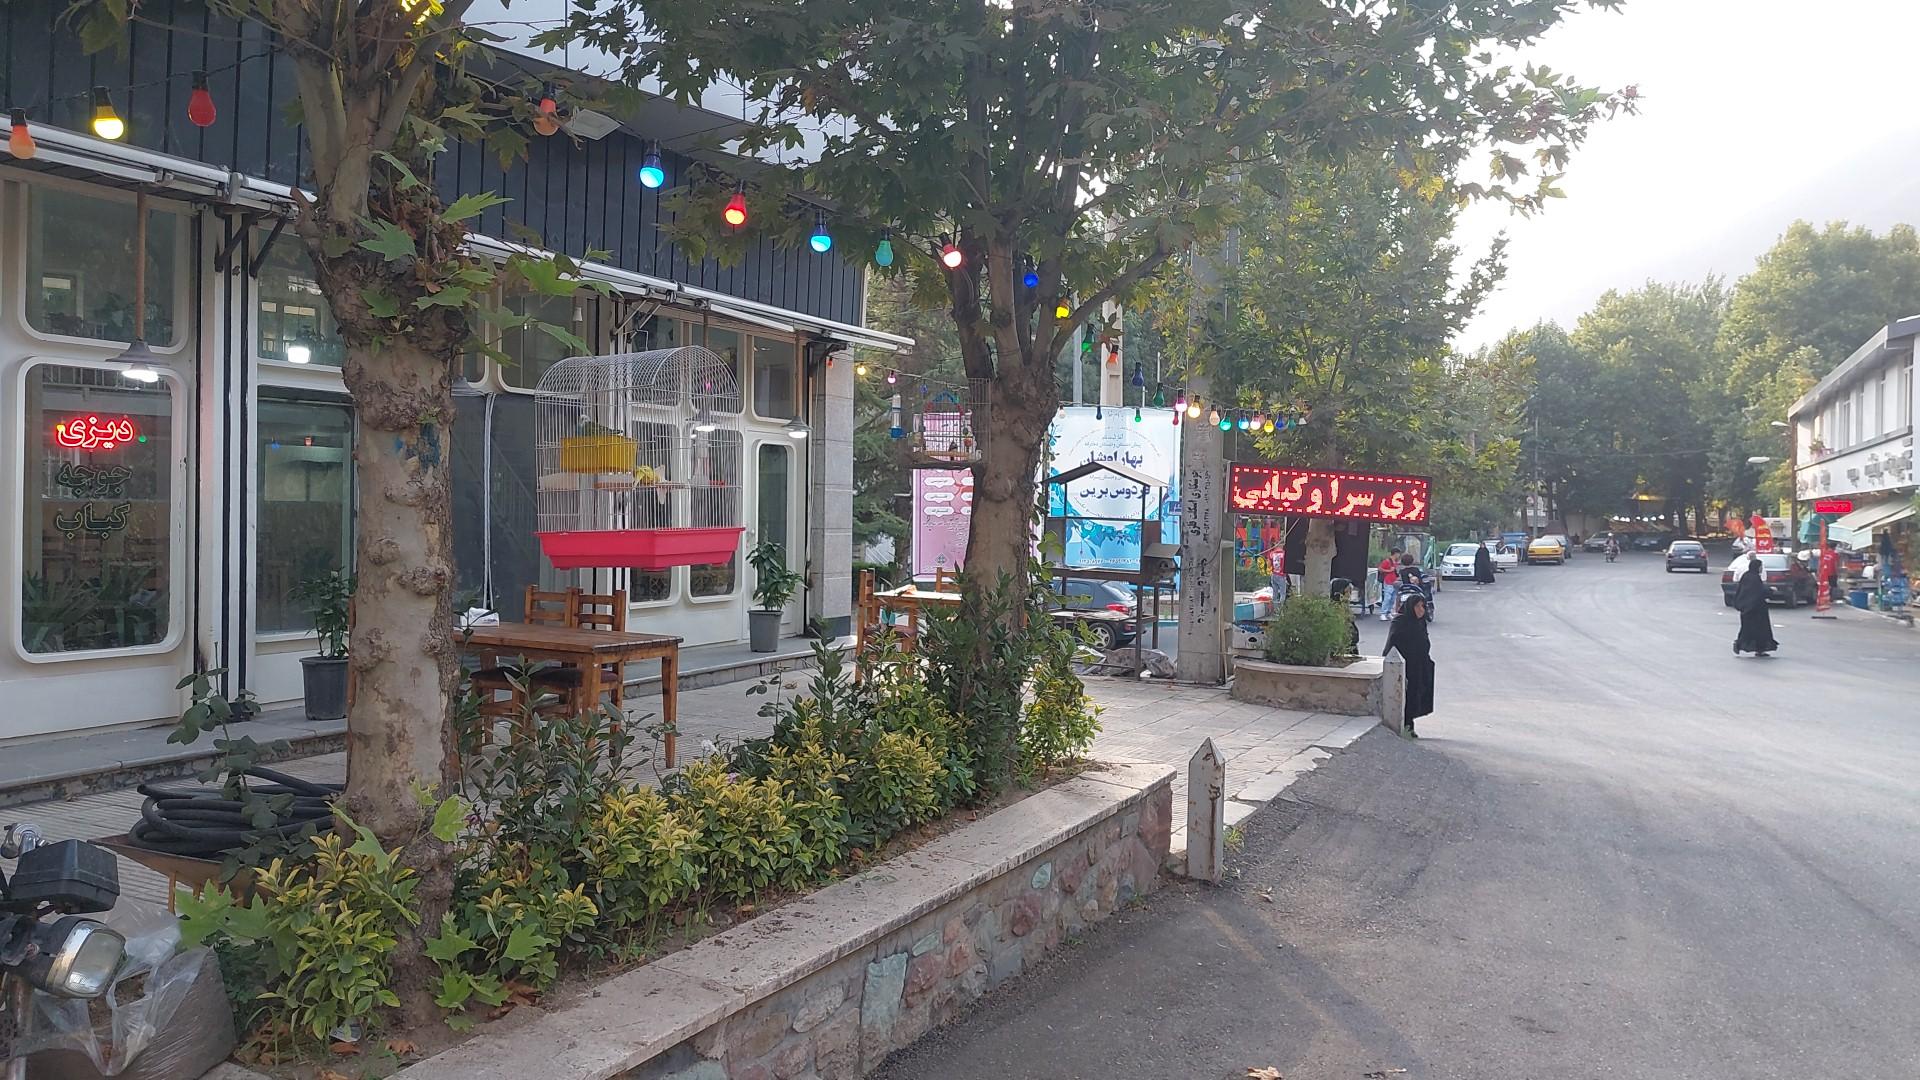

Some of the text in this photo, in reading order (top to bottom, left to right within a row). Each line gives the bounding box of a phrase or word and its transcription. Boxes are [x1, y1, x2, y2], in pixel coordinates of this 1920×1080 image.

[57, 417, 134, 448] دیزی
[57, 461, 132, 496] جوجه
[56, 502, 131, 539] کباب
